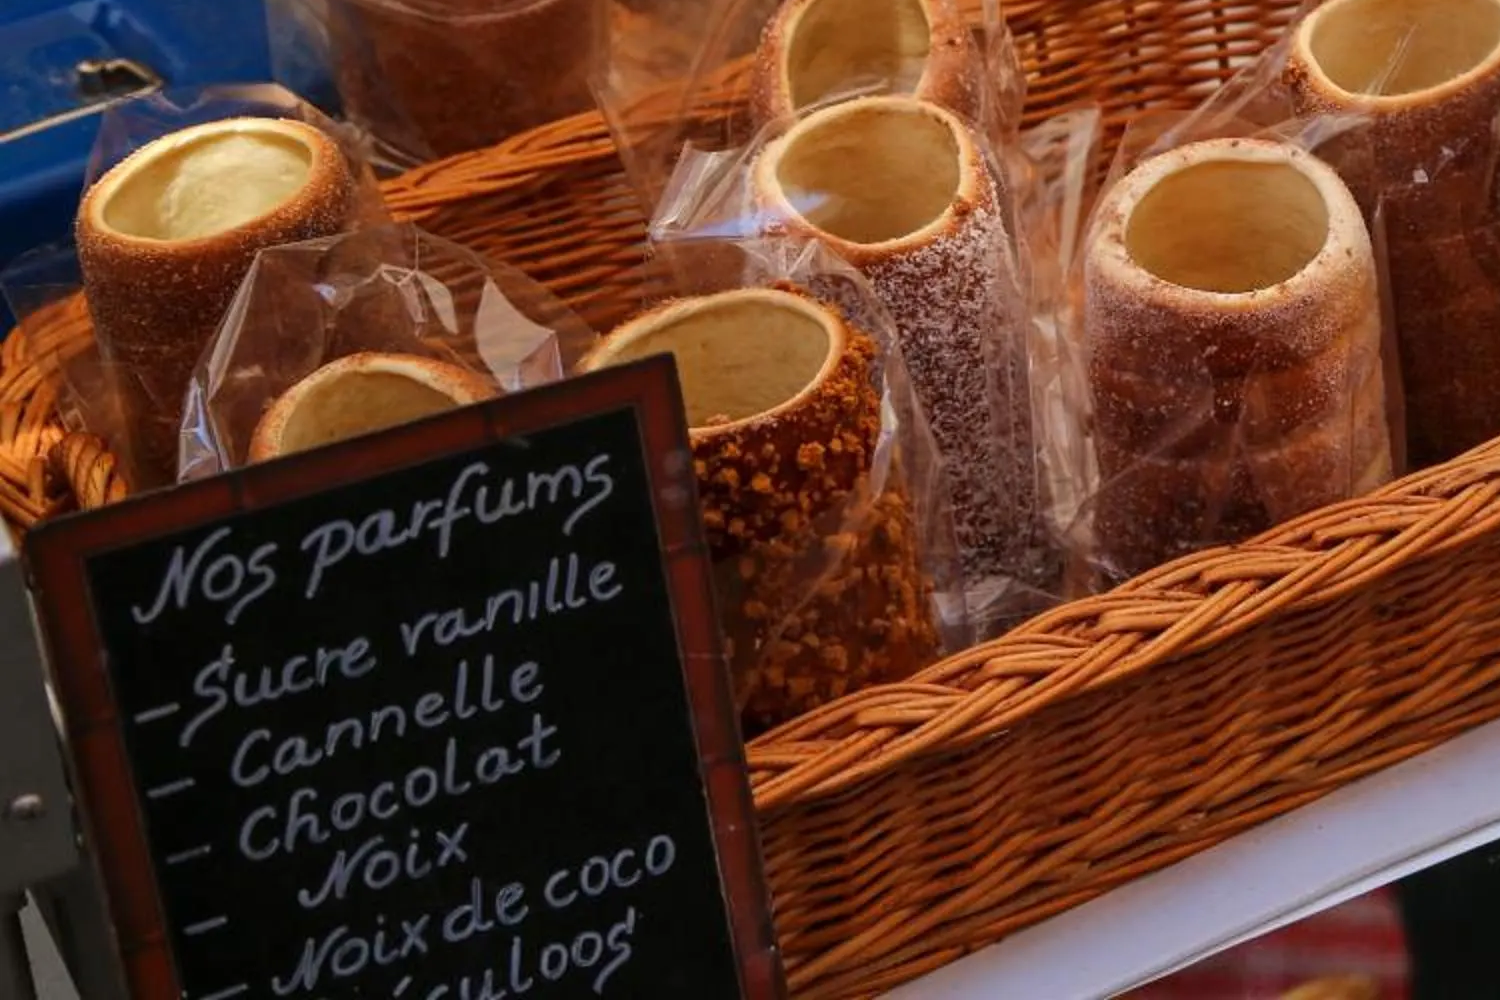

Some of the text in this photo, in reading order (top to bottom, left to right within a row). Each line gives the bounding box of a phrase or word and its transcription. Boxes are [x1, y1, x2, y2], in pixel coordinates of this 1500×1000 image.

[132, 454, 613, 625] Nos parfums
[181, 644, 376, 747] Sucre
[231, 654, 543, 786] Cannelle
[239, 713, 561, 859] Chocolat
[272, 834, 675, 995] Noix de coco
[298, 822, 469, 908] Noix
